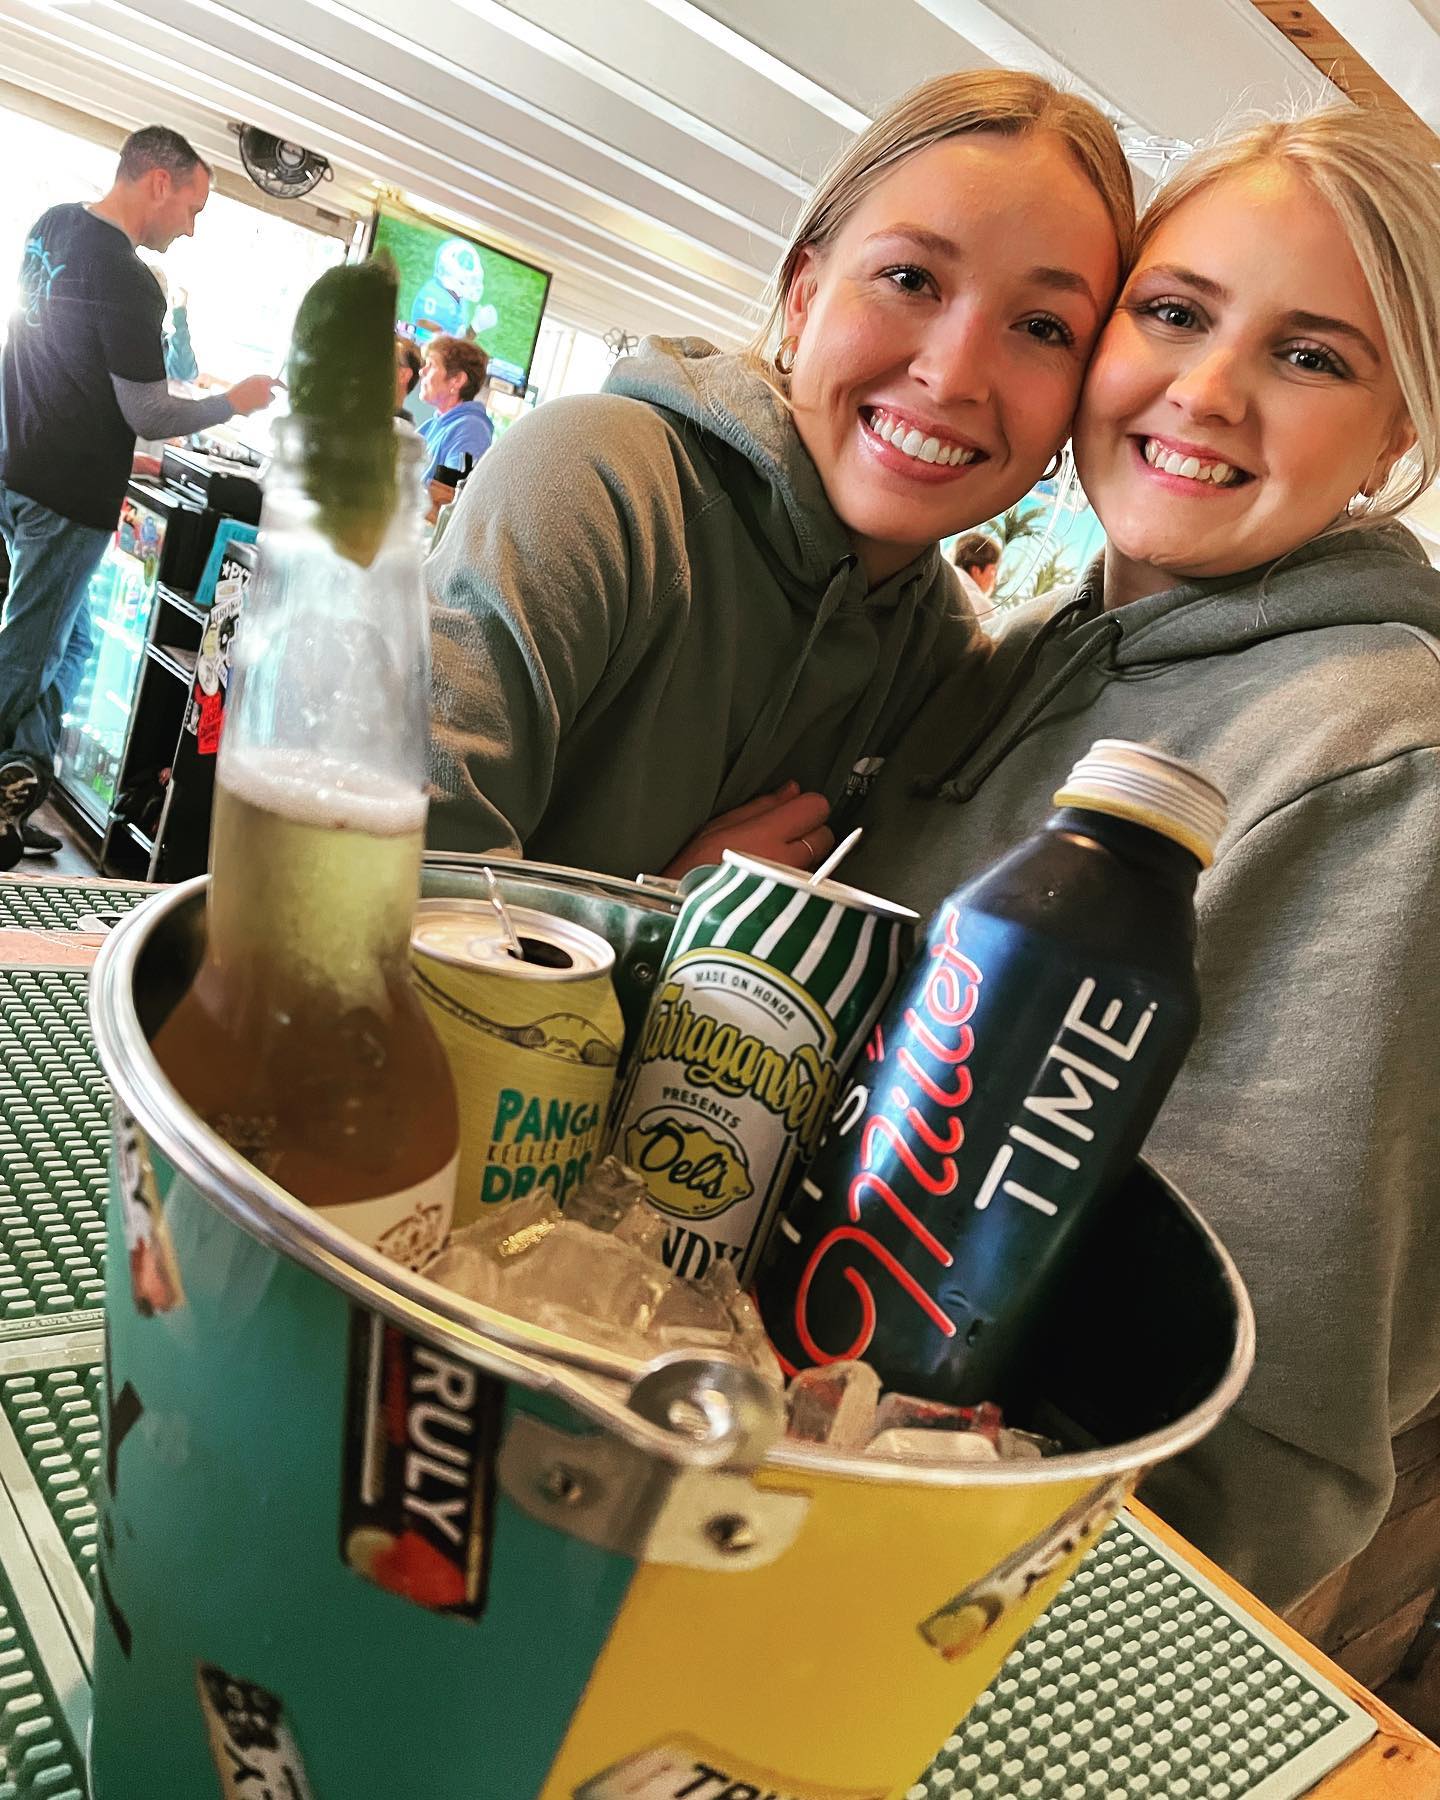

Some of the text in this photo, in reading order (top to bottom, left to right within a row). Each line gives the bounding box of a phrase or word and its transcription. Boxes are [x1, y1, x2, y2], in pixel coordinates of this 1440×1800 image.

[694, 970, 797, 1022] MADE ON HONOR
[662, 1086, 742, 1129] PRESENTS
[796, 908, 984, 1366] Miller
[974, 976, 1160, 1218] TIME
[403, 1344, 478, 1545] RULY
